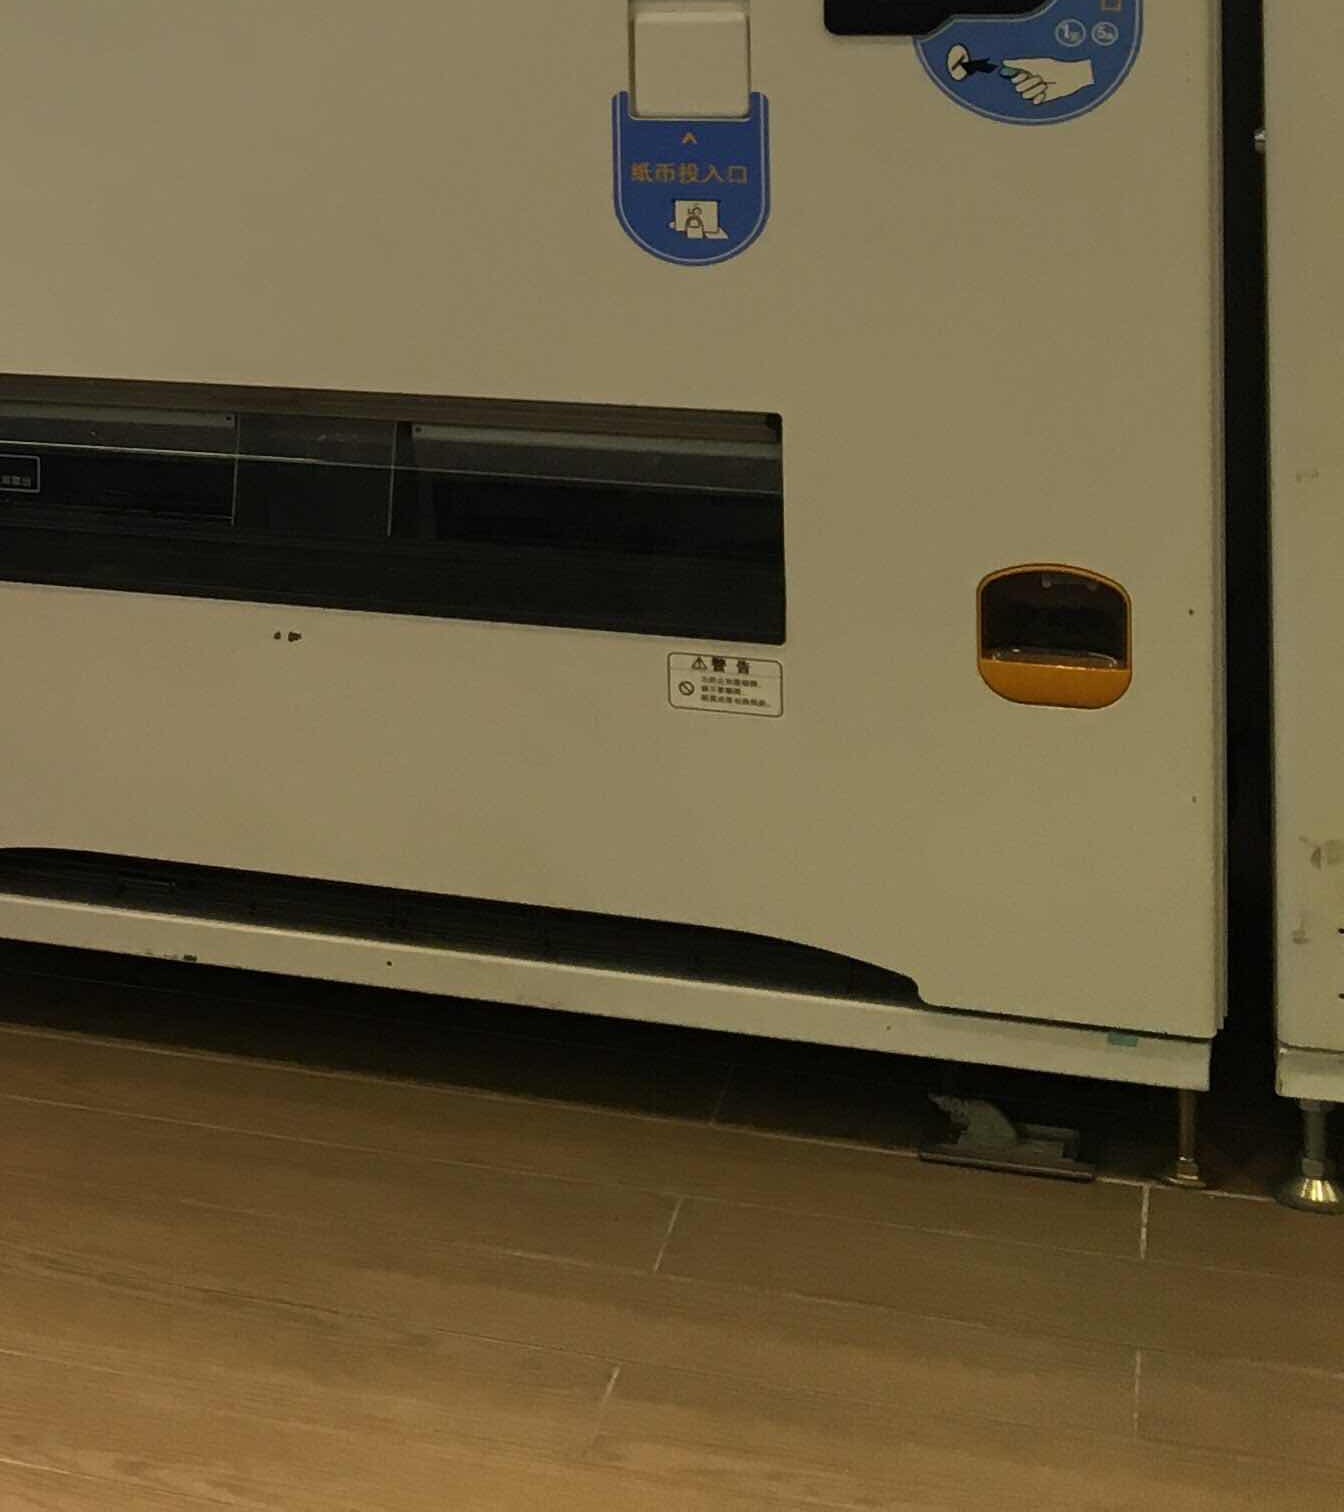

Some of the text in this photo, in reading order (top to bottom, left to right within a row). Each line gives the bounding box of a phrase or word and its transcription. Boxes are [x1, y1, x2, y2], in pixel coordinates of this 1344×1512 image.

[631, 162, 748, 185] 纸币投入口
